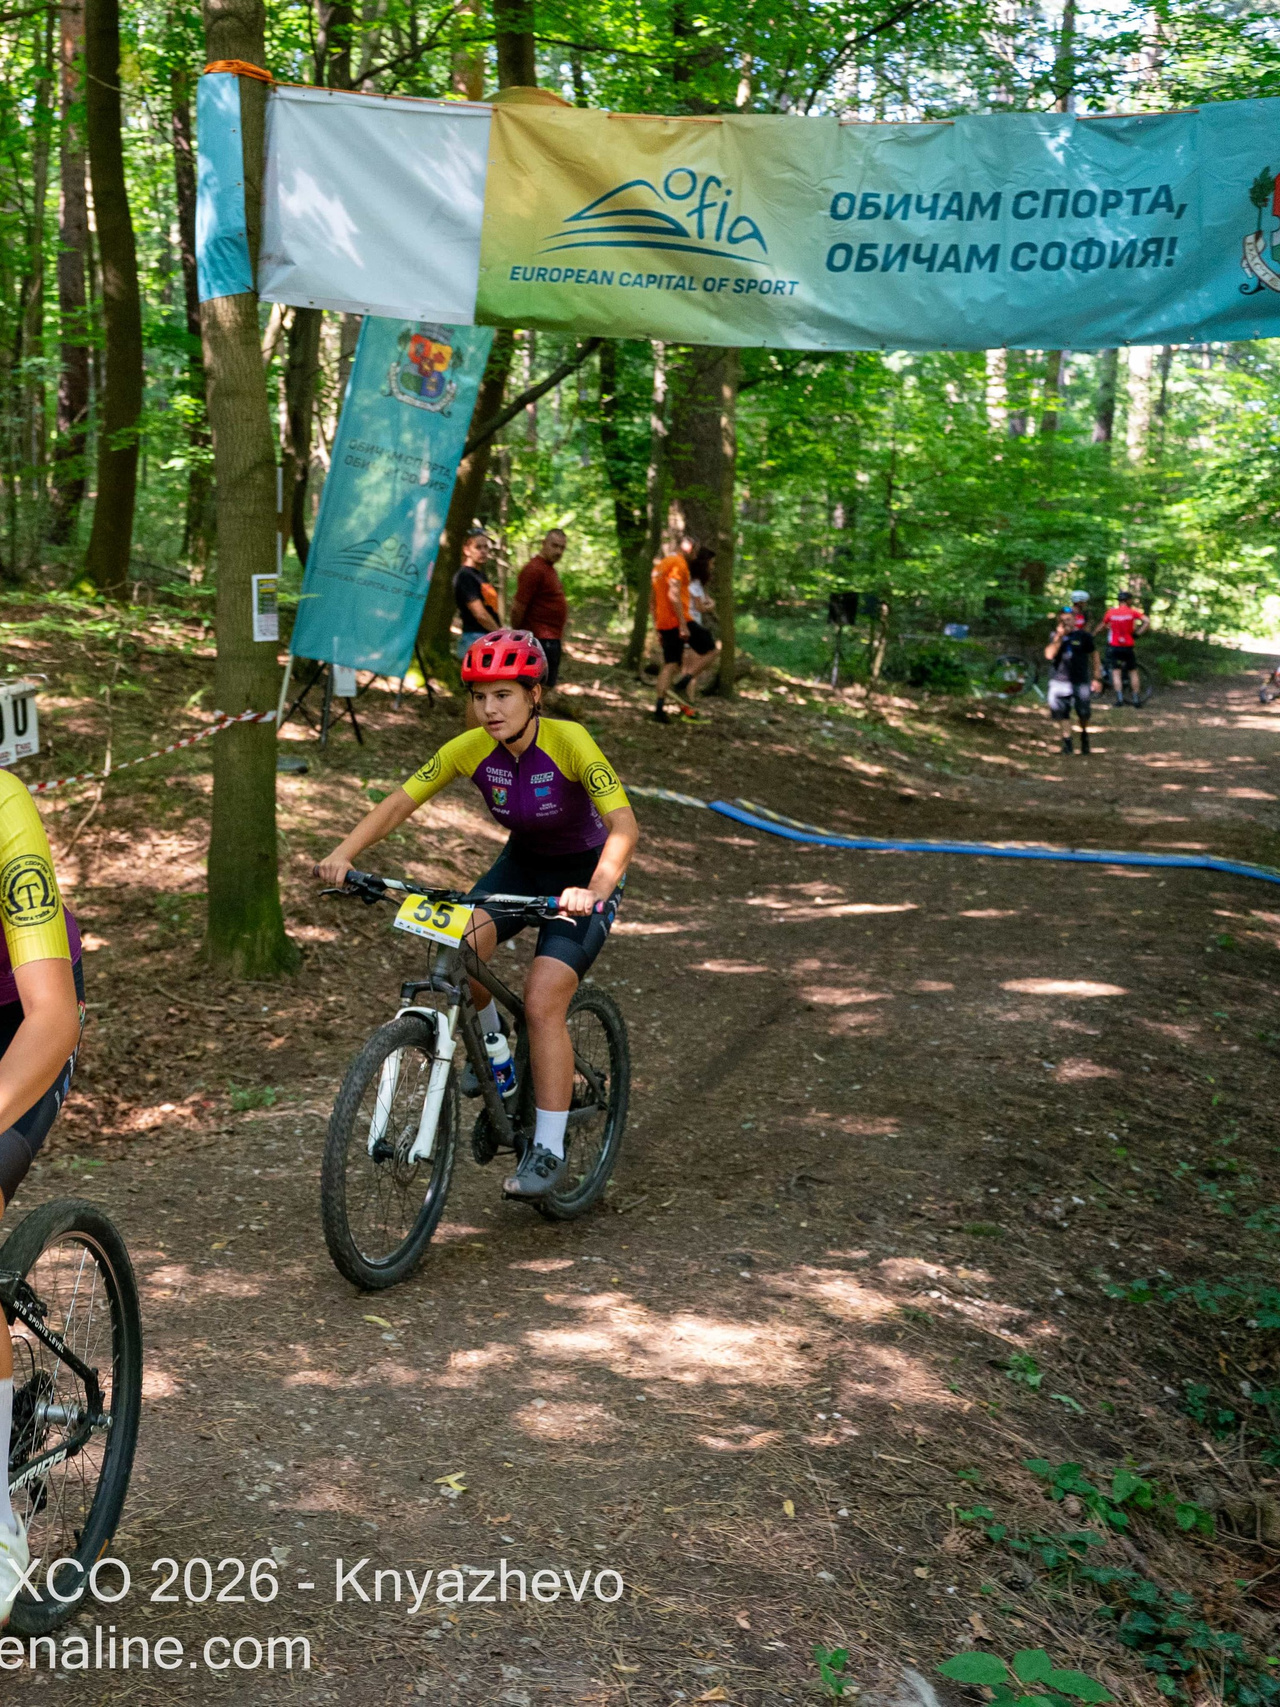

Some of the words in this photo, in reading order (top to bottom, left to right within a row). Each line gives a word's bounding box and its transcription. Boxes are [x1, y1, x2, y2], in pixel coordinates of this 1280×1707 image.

[830, 191, 1003, 222] ОБИЧАМ
[1010, 184, 1188, 221] СПОРТА,
[825, 241, 1000, 274] ОБИЧАМ
[1009, 236, 1179, 274] СОФИЯ!
[509, 265, 614, 286] EUROPEAN
[619, 271, 699, 292] CAPITAL
[702, 276, 731, 293] OF
[733, 277, 800, 297] SPORT
[485, 766, 514, 779] ОМЕГА
[486, 774, 513, 786] ТИЙМ
[413, 899, 455, 929] 55
[13, 1300, 28, 1316] MTB
[28, 1313, 49, 1338] SPORTS
[48, 1333, 65, 1354] LEVEL
